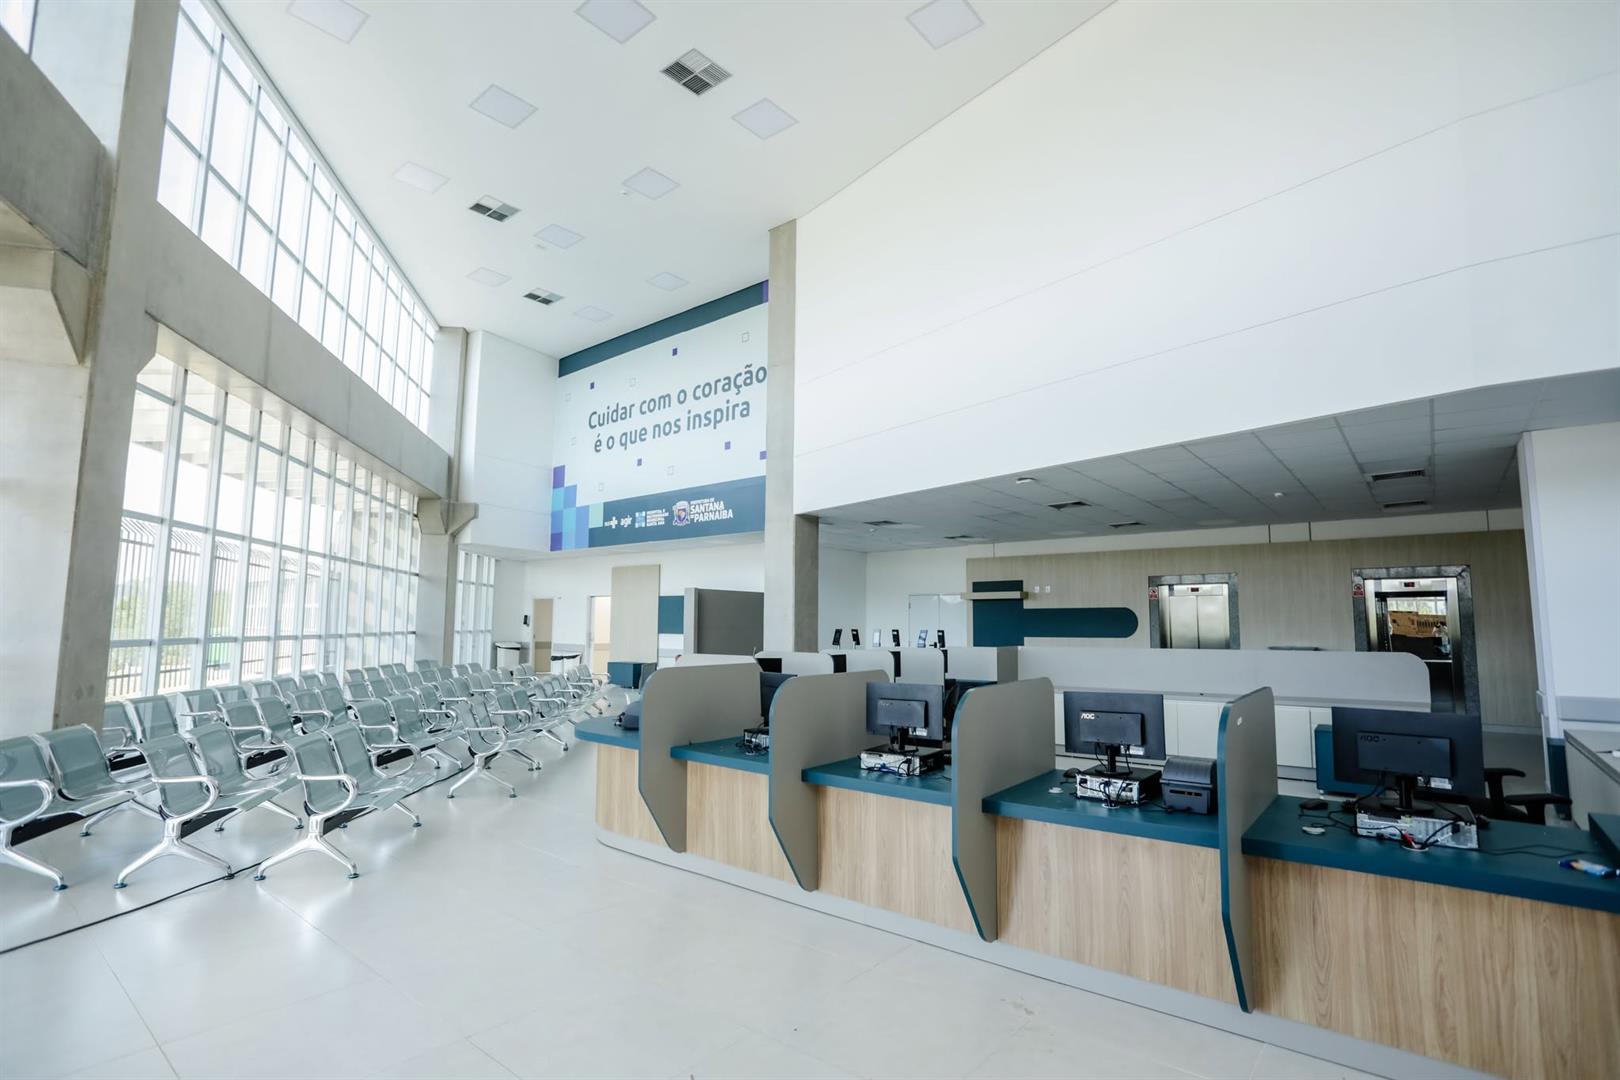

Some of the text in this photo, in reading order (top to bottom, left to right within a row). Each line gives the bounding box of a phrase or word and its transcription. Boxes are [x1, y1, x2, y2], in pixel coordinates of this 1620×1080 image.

[588, 364, 767, 429] Cuidar com o coração
[594, 400, 750, 452] é o que nos inspira
[690, 501, 725, 514] SANTANA
